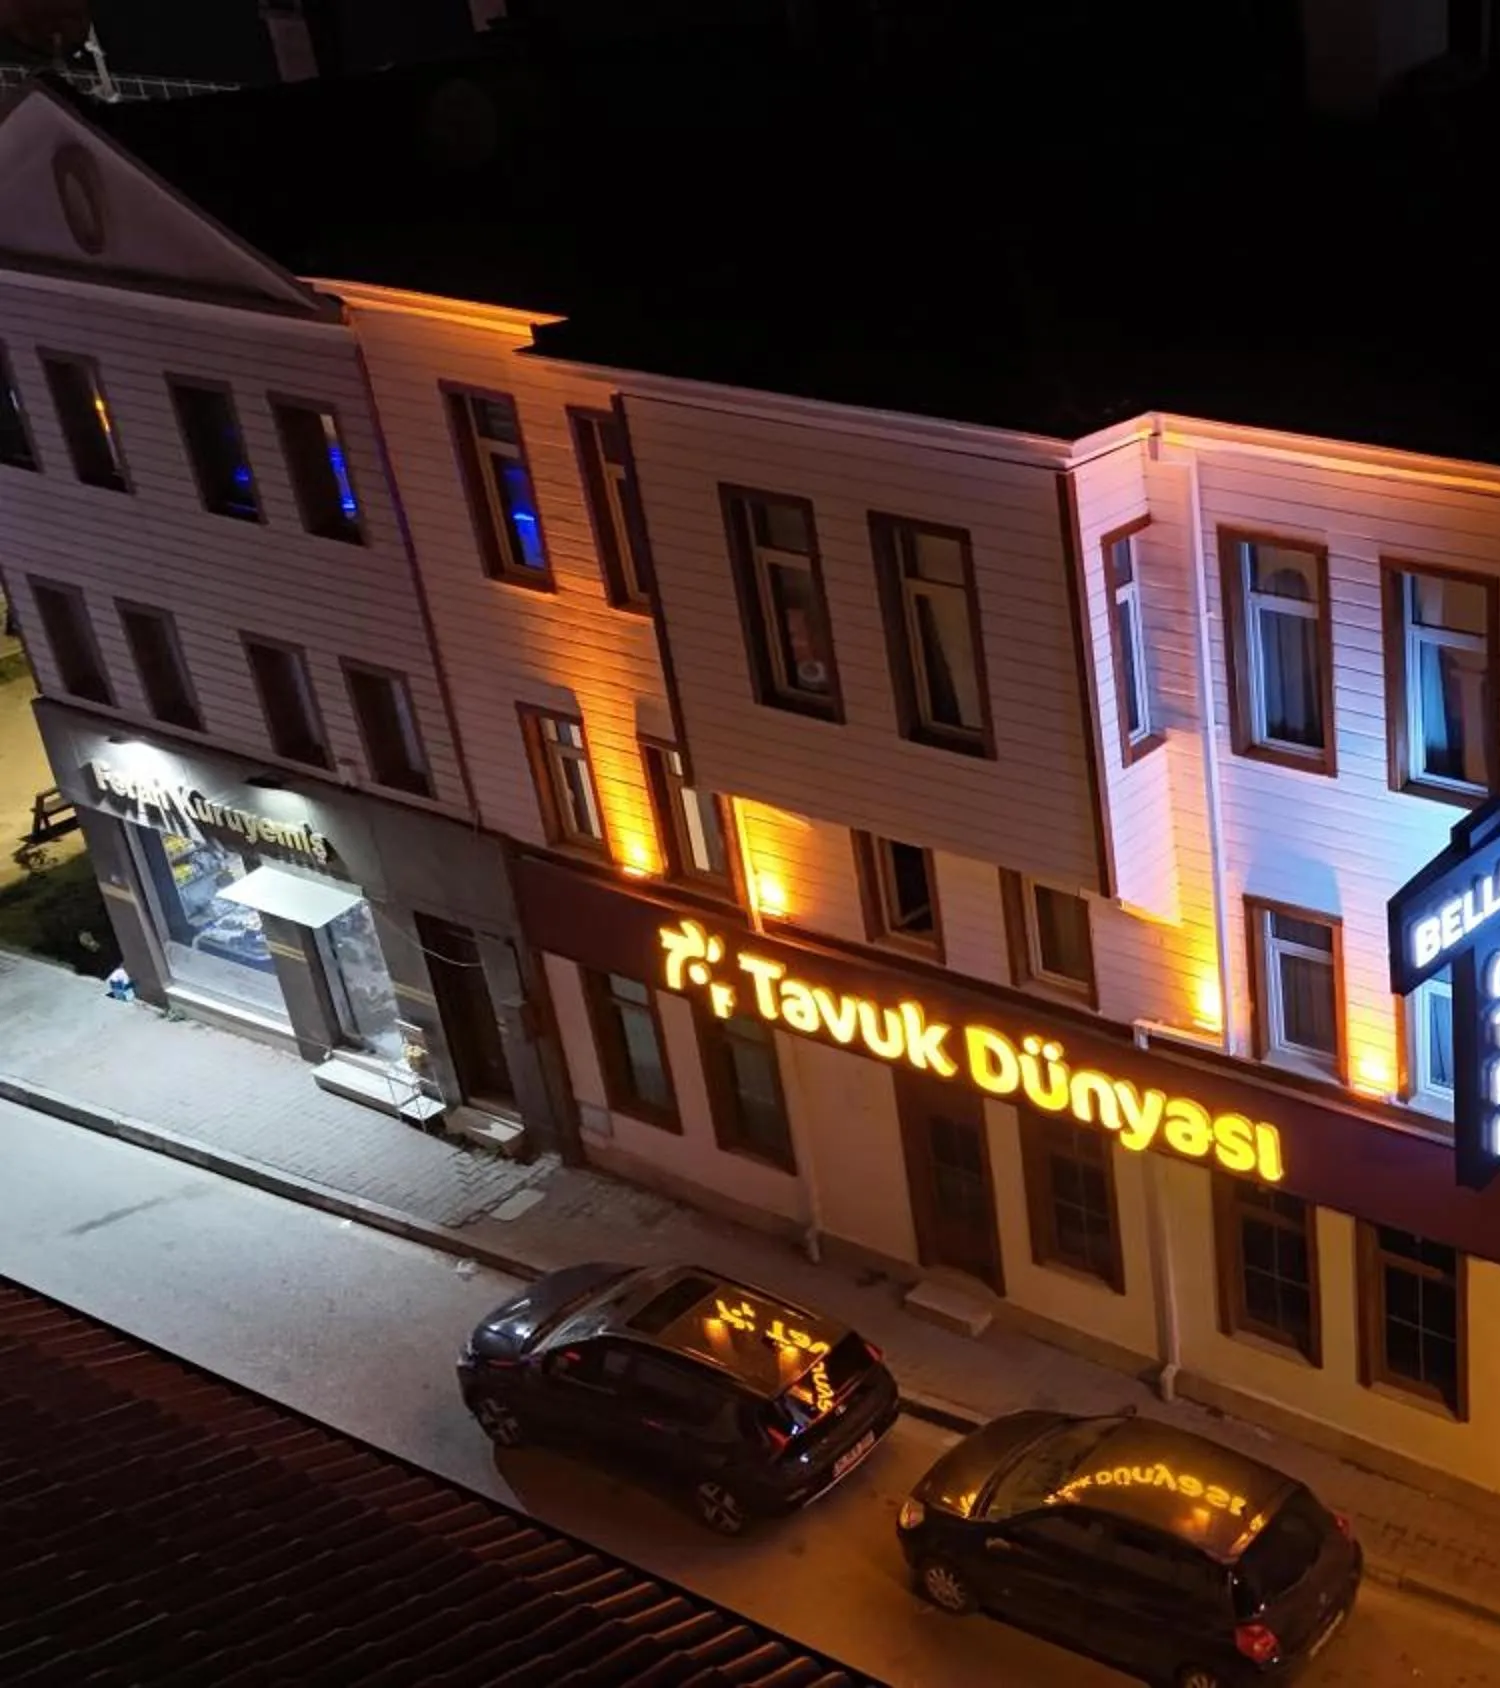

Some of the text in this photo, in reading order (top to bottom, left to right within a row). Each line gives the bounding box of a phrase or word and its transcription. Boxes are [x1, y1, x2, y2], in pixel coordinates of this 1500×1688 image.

[173, 784, 327, 864] Kuruyemiş
[738, 953, 1284, 1181] Tavuk Dünyası
